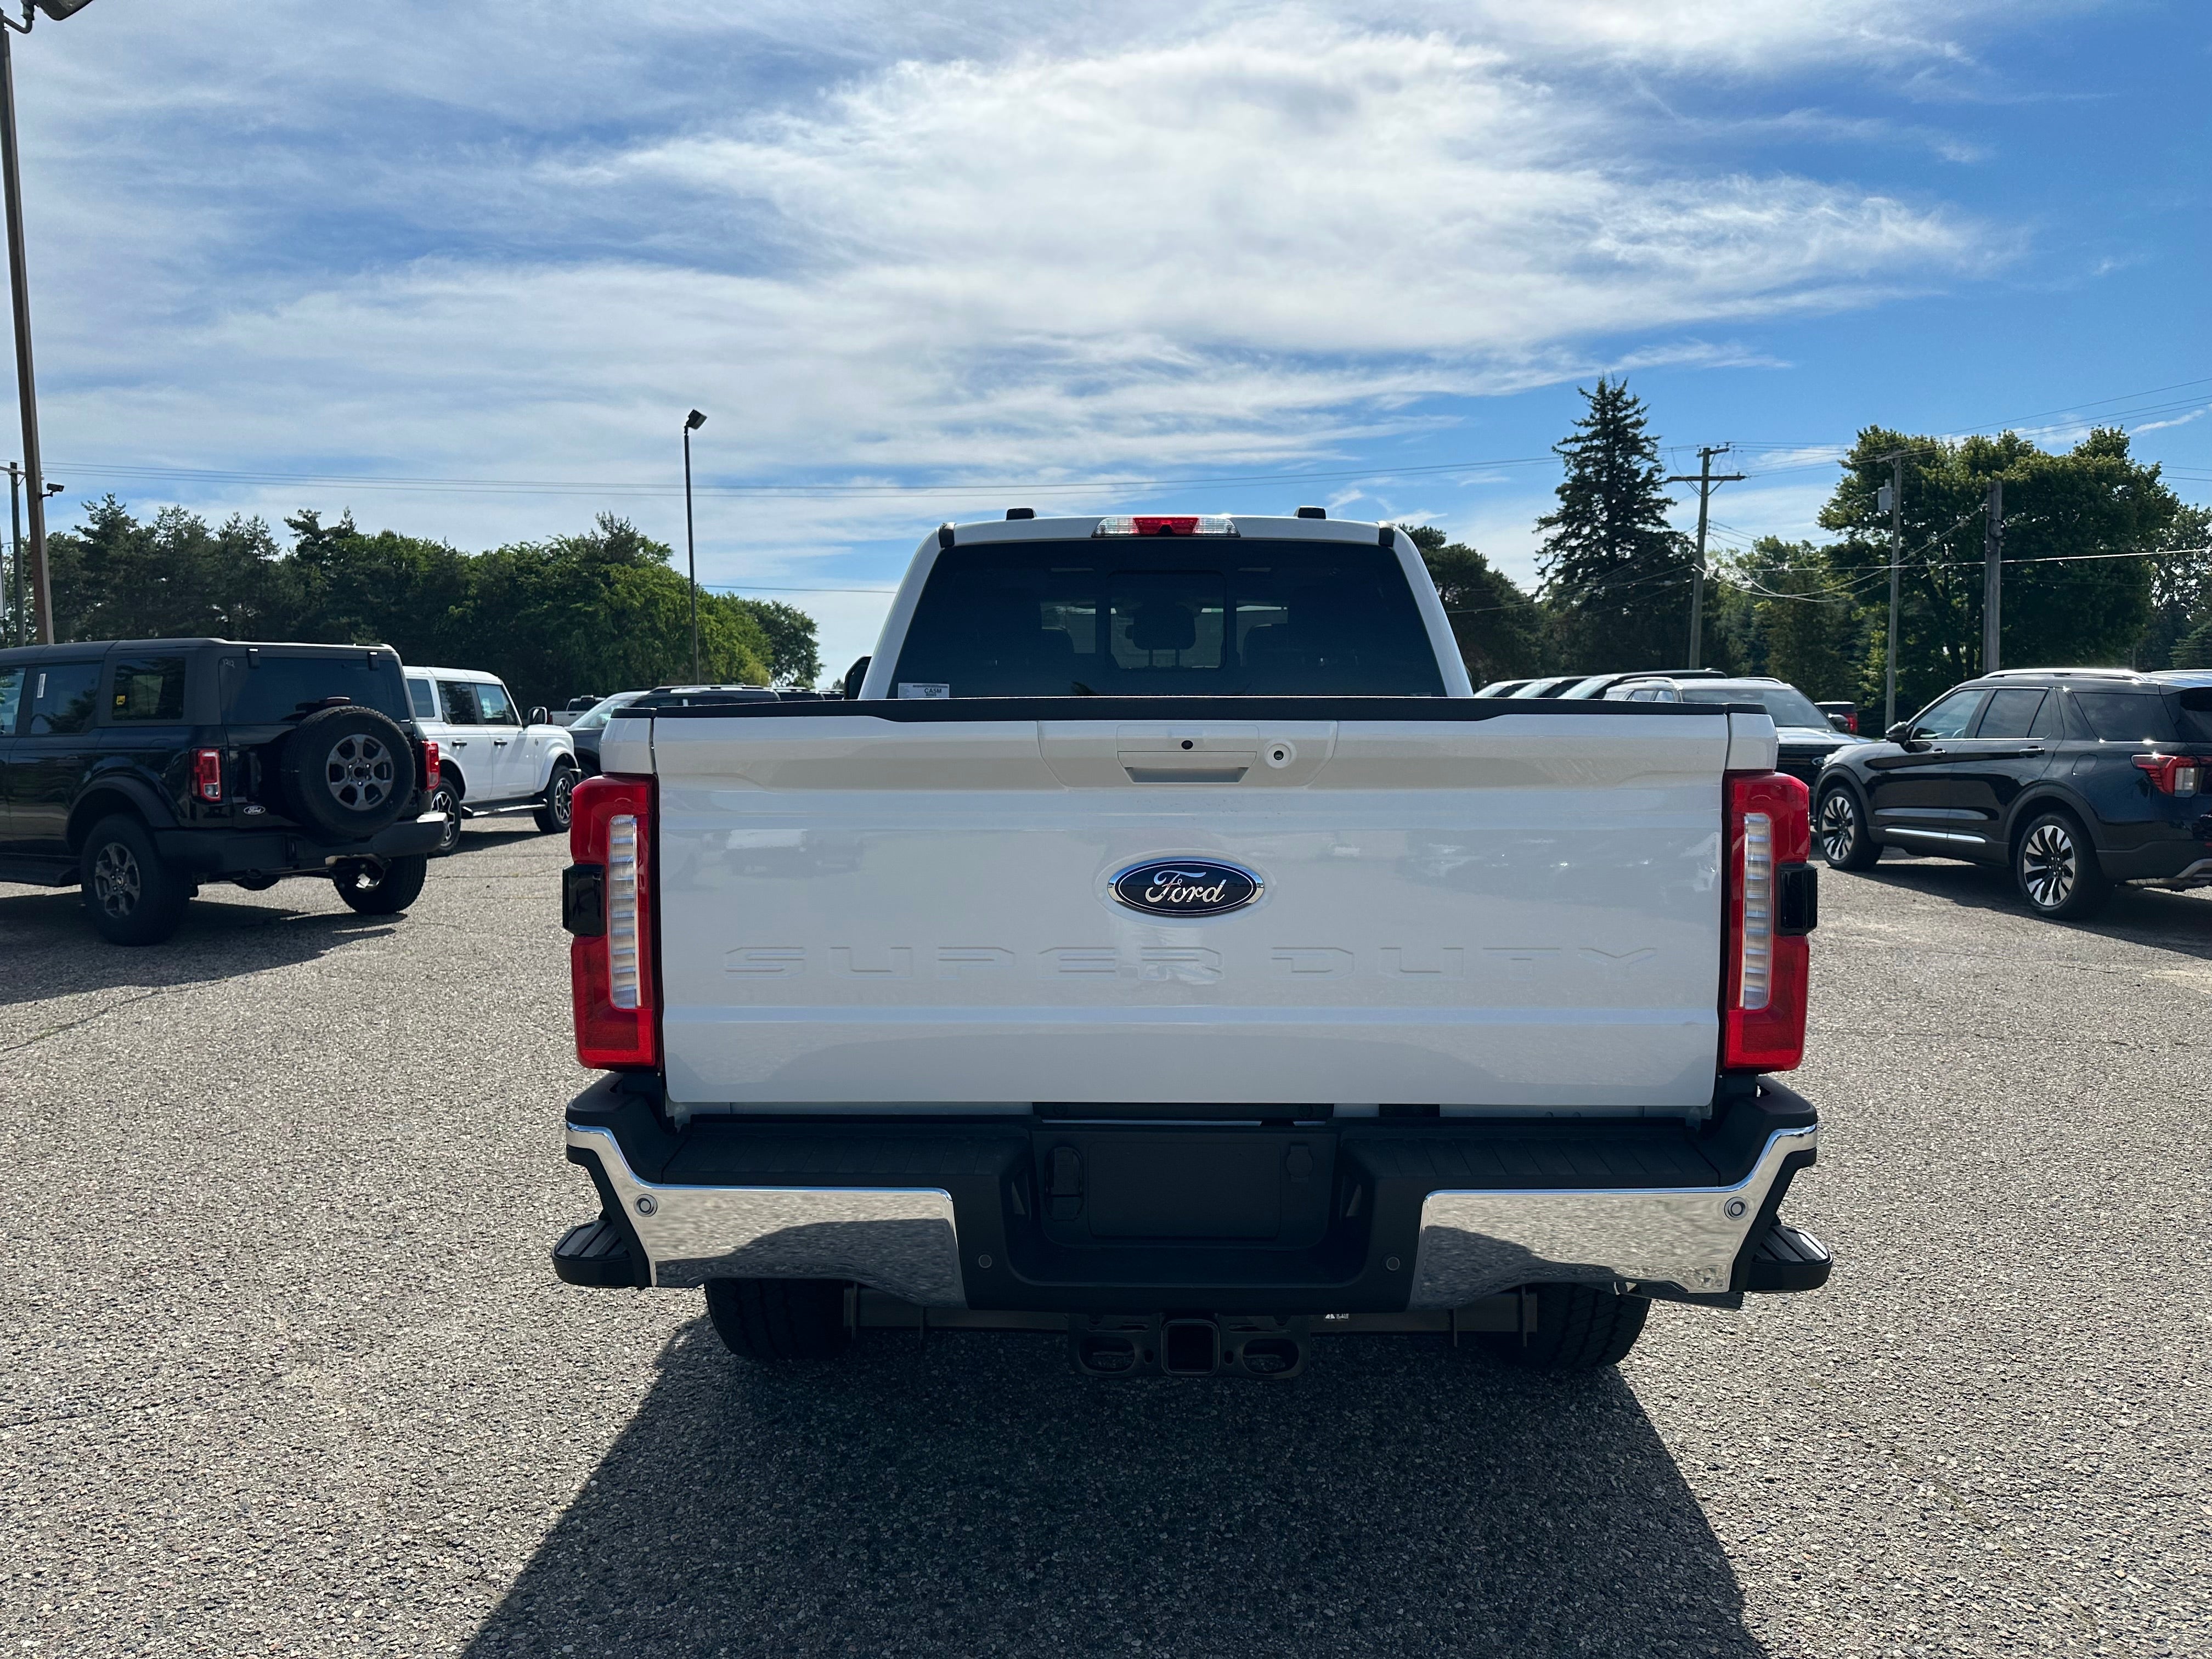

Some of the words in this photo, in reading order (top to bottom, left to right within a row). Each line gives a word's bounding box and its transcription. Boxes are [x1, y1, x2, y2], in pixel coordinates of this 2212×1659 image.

[1145, 870, 1227, 903] Ford
[724, 947, 1225, 981] SUPER
[1271, 947, 1658, 981] DUTY
